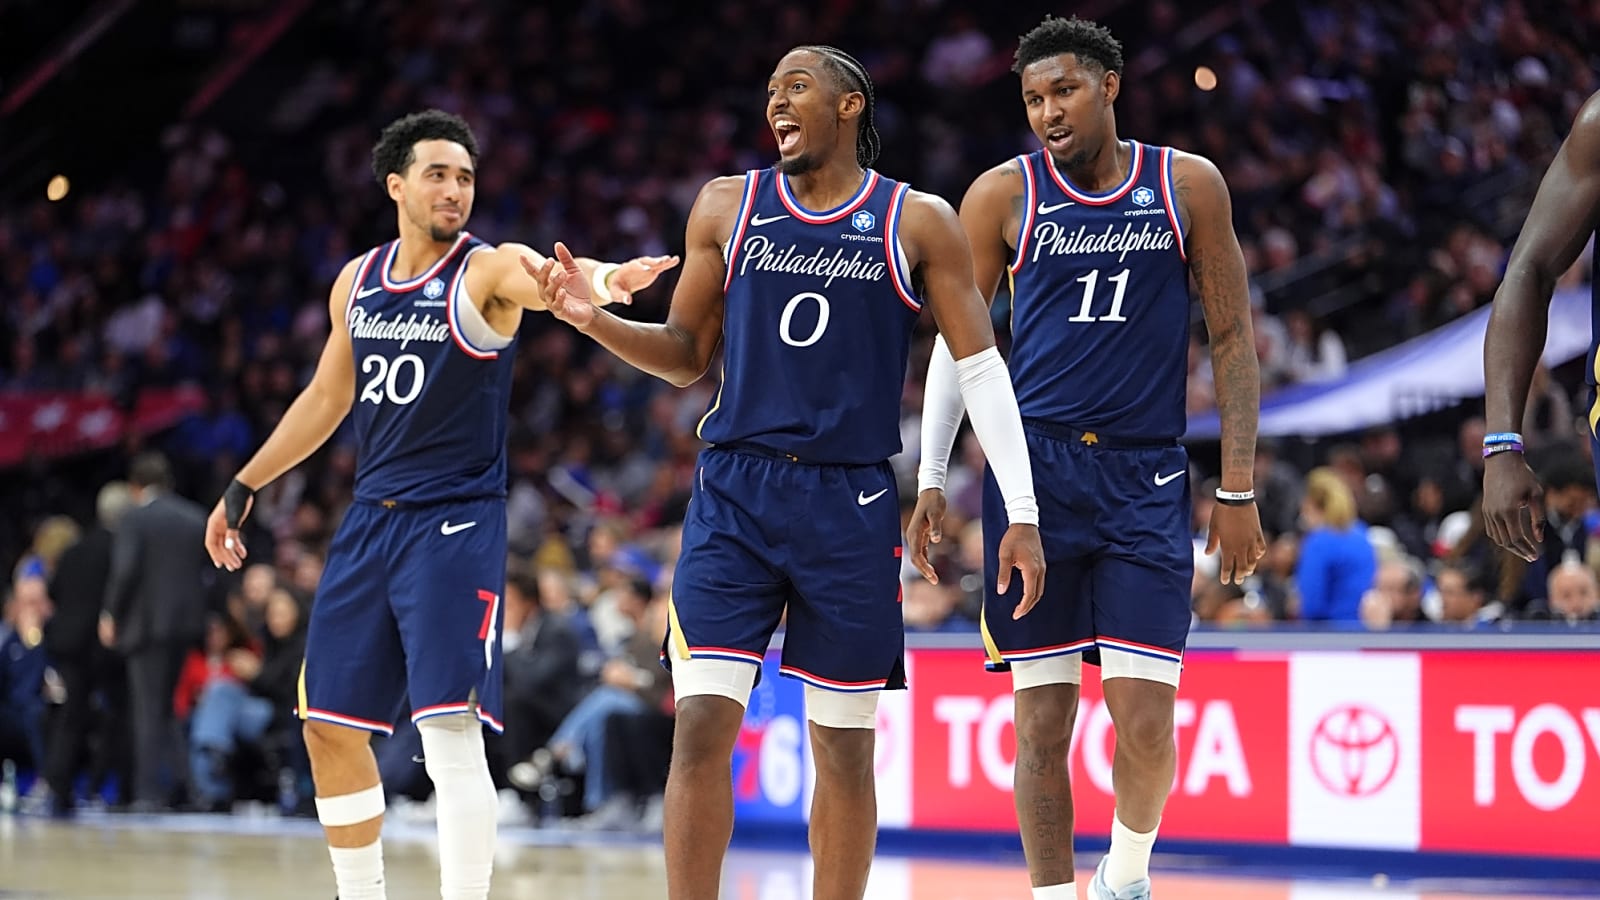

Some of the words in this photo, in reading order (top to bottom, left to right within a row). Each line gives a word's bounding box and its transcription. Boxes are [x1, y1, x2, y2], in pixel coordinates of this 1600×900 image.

[1124, 208, 1166, 217] crypto.com
[840, 232, 883, 243] crypto.com
[1032, 221, 1174, 264] Philadelphia
[740, 235, 886, 289] Philadelphia
[1068, 268, 1130, 323] 11
[349, 306, 449, 350] Philadelphia
[779, 292, 830, 348] 0
[360, 354, 425, 405] 20
